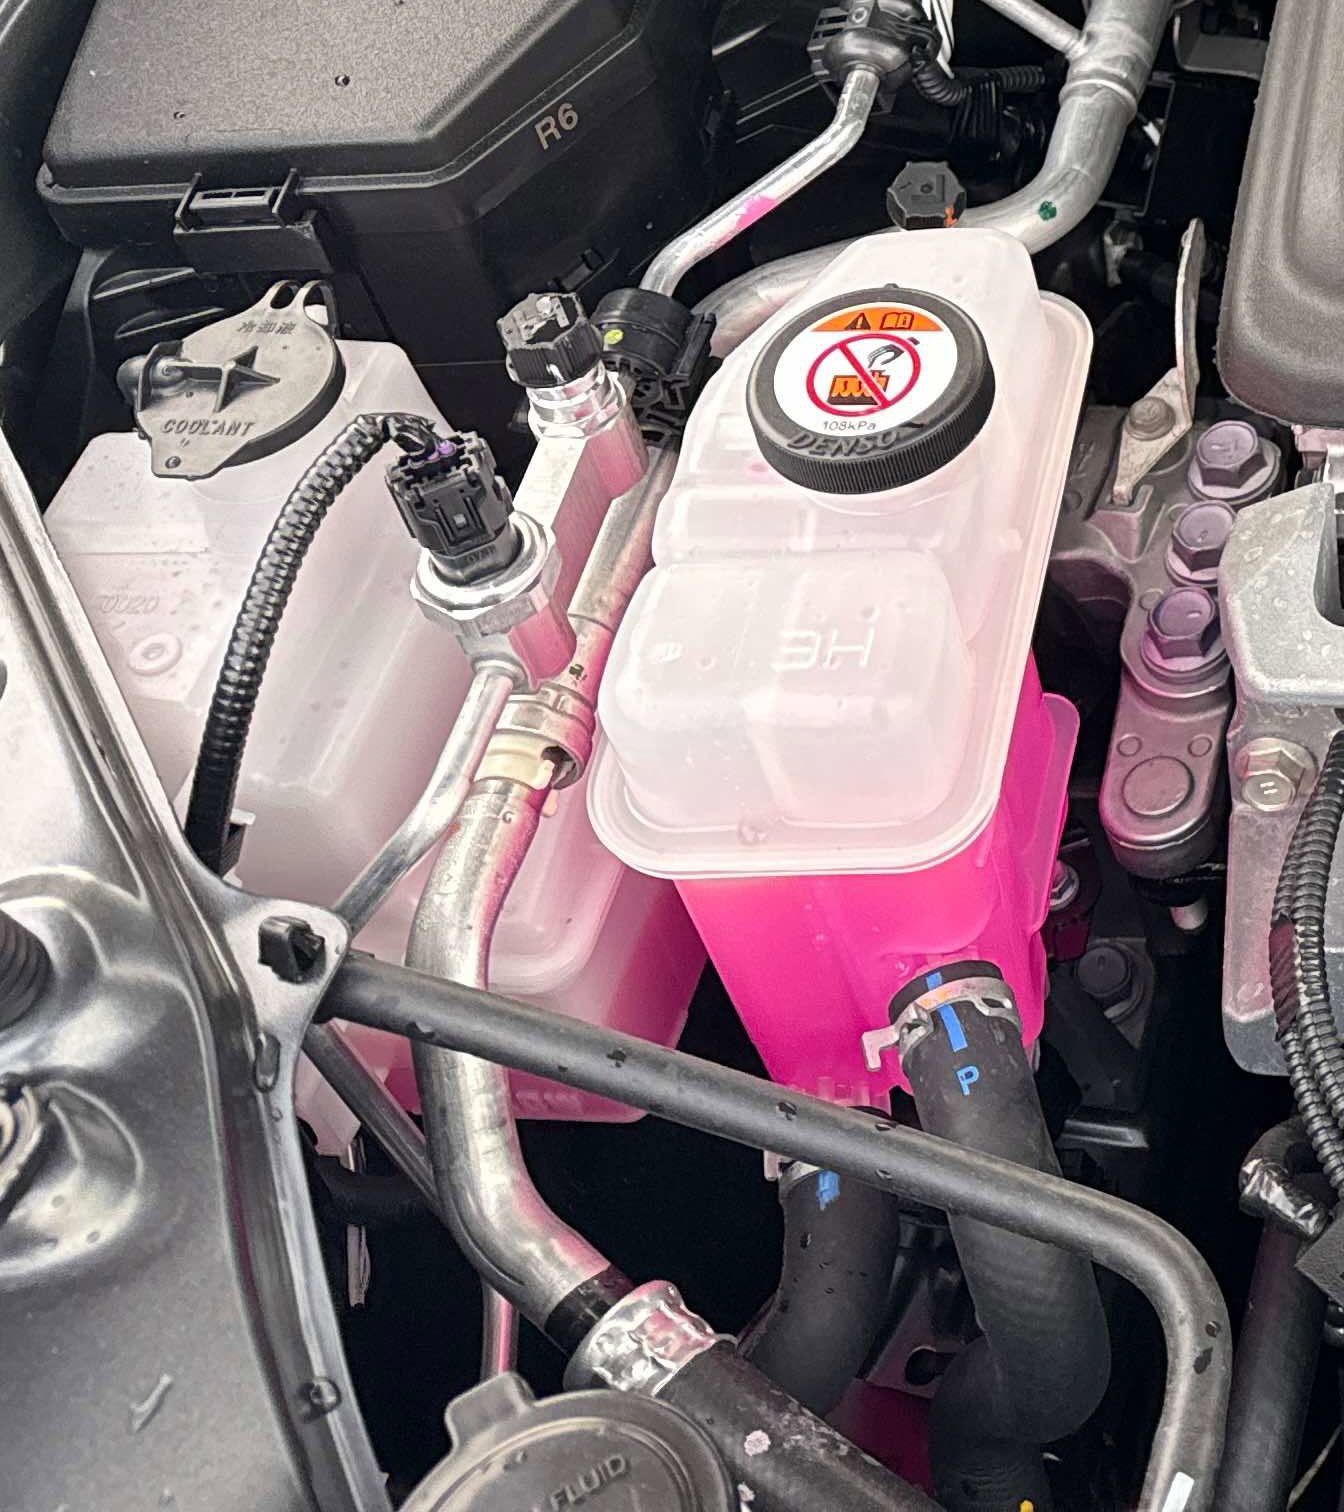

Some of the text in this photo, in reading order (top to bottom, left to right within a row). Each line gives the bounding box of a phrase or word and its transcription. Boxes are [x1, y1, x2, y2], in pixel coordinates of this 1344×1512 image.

[535, 103, 578, 150] R6
[161, 418, 254, 437] COOLANT
[823, 420, 877, 431] 108kPa
[788, 429, 898, 456] DENSO
[957, 1065, 980, 1096] P
[550, 1453, 632, 1511] FLUID
